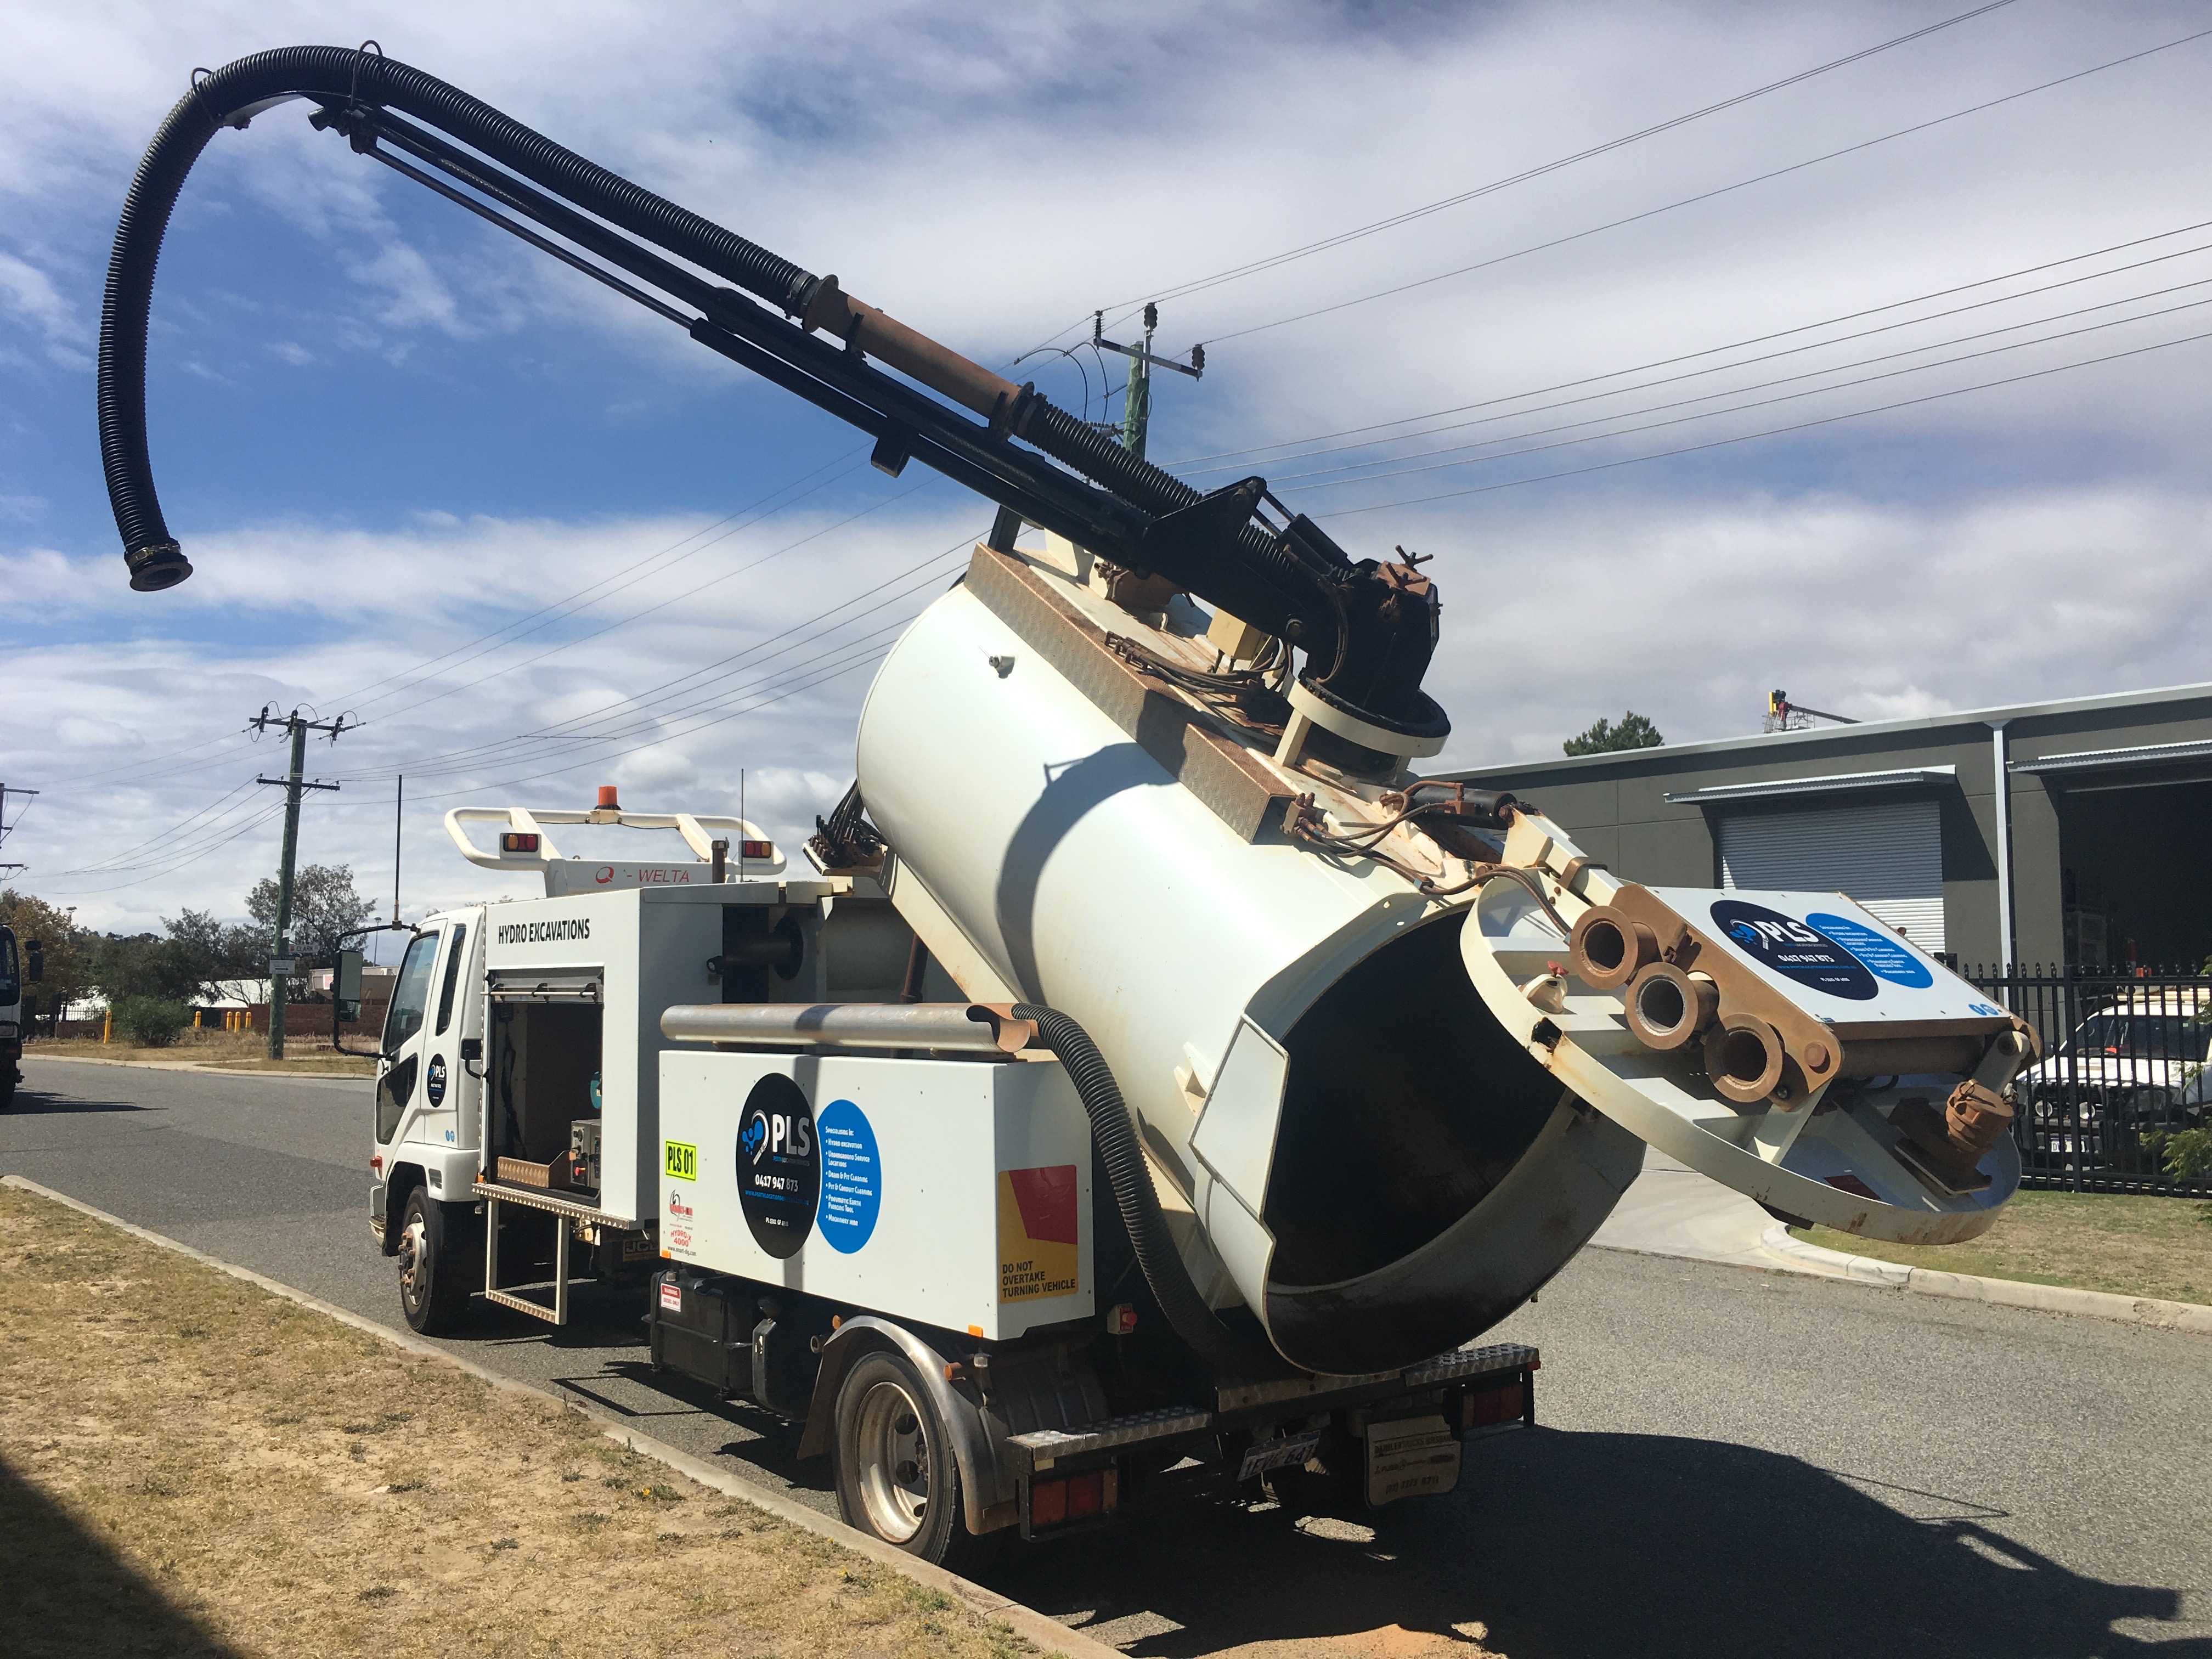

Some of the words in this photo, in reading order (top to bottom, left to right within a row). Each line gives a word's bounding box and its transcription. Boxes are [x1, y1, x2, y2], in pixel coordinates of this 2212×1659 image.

[639, 869, 690, 883] WELTA
[499, 923, 527, 944] HYDRO
[529, 918, 590, 942] EXCAVATIONS
[1753, 921, 1819, 943] PLS
[1815, 954, 1835, 962] 873
[435, 1065, 445, 1078] PLS
[772, 1114, 810, 1156] PLS
[668, 1146, 682, 1173] PLS
[684, 1148, 693, 1175] 01
[755, 1173, 771, 1188] 0417
[772, 1176, 785, 1190] 947
[786, 1178, 798, 1192] 873
[674, 1237, 689, 1247] 4000
[1002, 1263, 1014, 1274] DO
[1017, 1261, 1033, 1272] NOT
[1002, 1271, 1046, 1285] OVERTAKE
[1002, 1283, 1040, 1298] TURNING
[1041, 1278, 1075, 1293] VEHICLE
